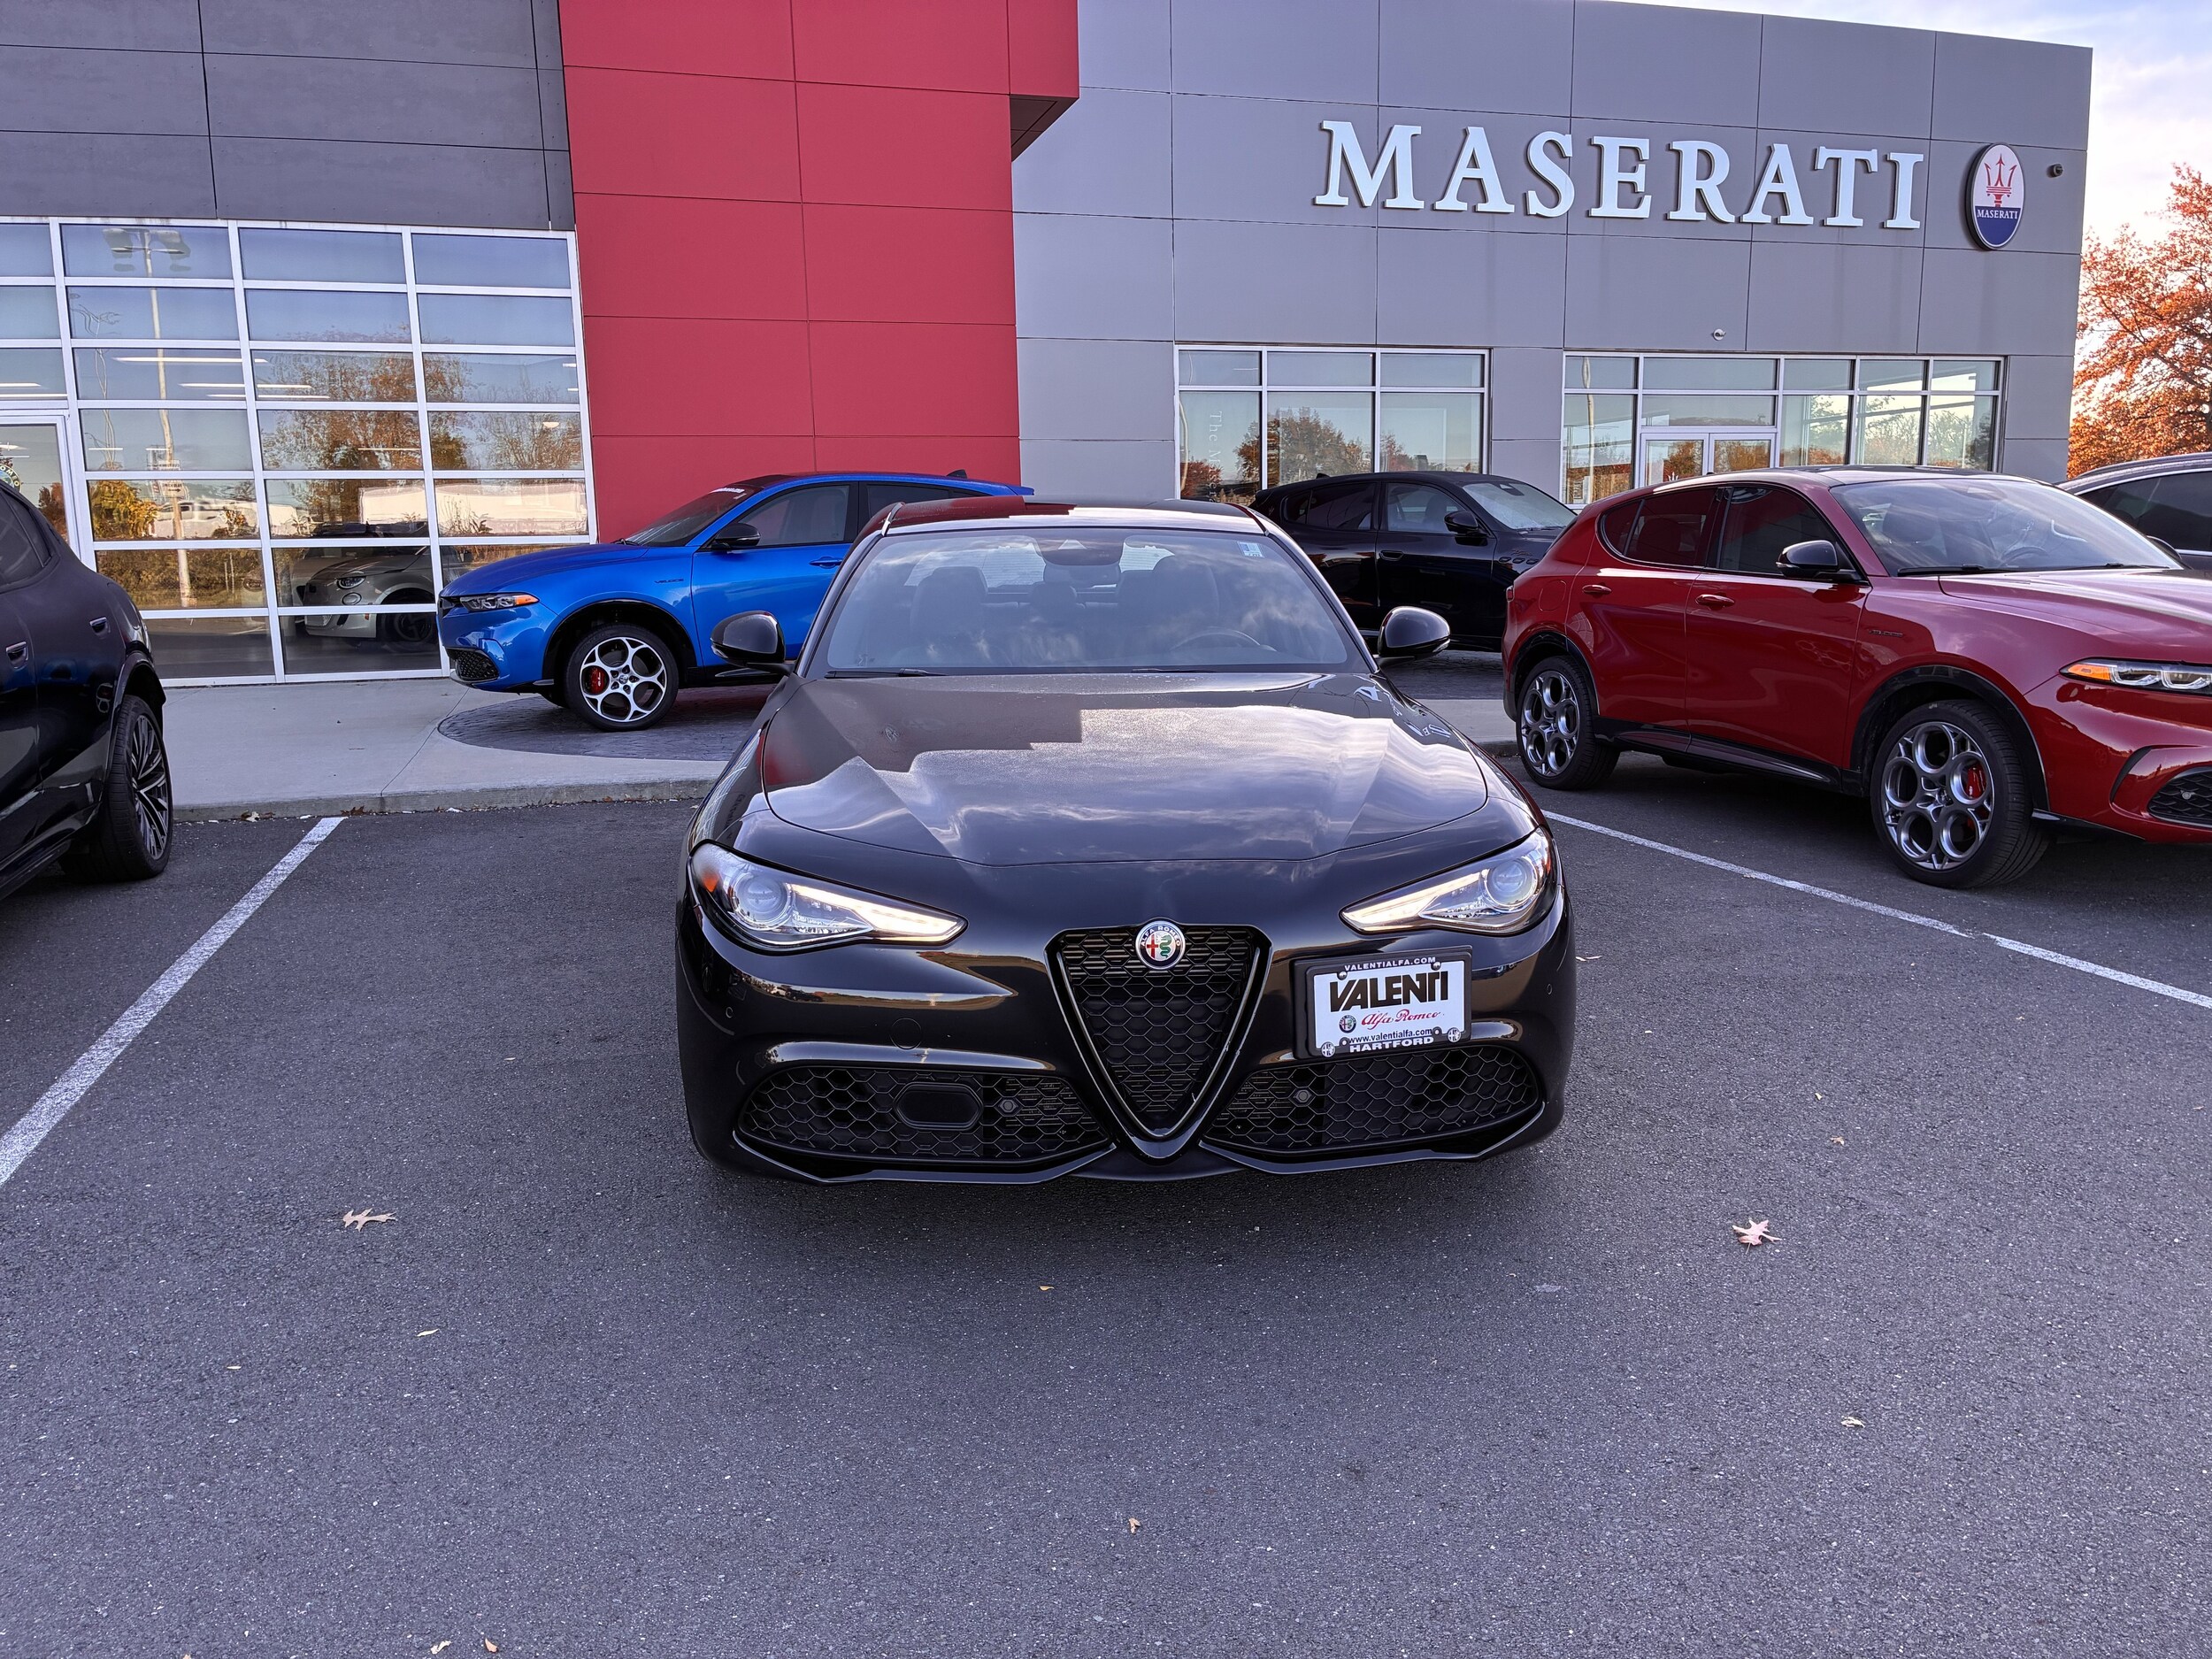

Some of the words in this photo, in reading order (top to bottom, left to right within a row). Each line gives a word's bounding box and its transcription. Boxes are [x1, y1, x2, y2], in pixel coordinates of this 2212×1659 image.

[1313, 119, 1925, 230] MASERATI
[1977, 209, 2018, 219] MASERATI
[1209, 411, 1222, 442] The
[0, 465, 19, 487] OMEO
[1209, 449, 1221, 503] Masera
[1141, 929, 1154, 946] ALFA
[1158, 926, 1180, 947] ROMEO
[1345, 957, 1436, 971] VALENTIALFA.COM
[1330, 972, 1448, 1012] VALENTI
[1361, 1013, 1394, 1030] Alfa
[1394, 1010, 1440, 1022] Romeo
[1348, 1028, 1432, 1043] www.valentialfa.com
[1349, 1036, 1434, 1053] HARTFORD
